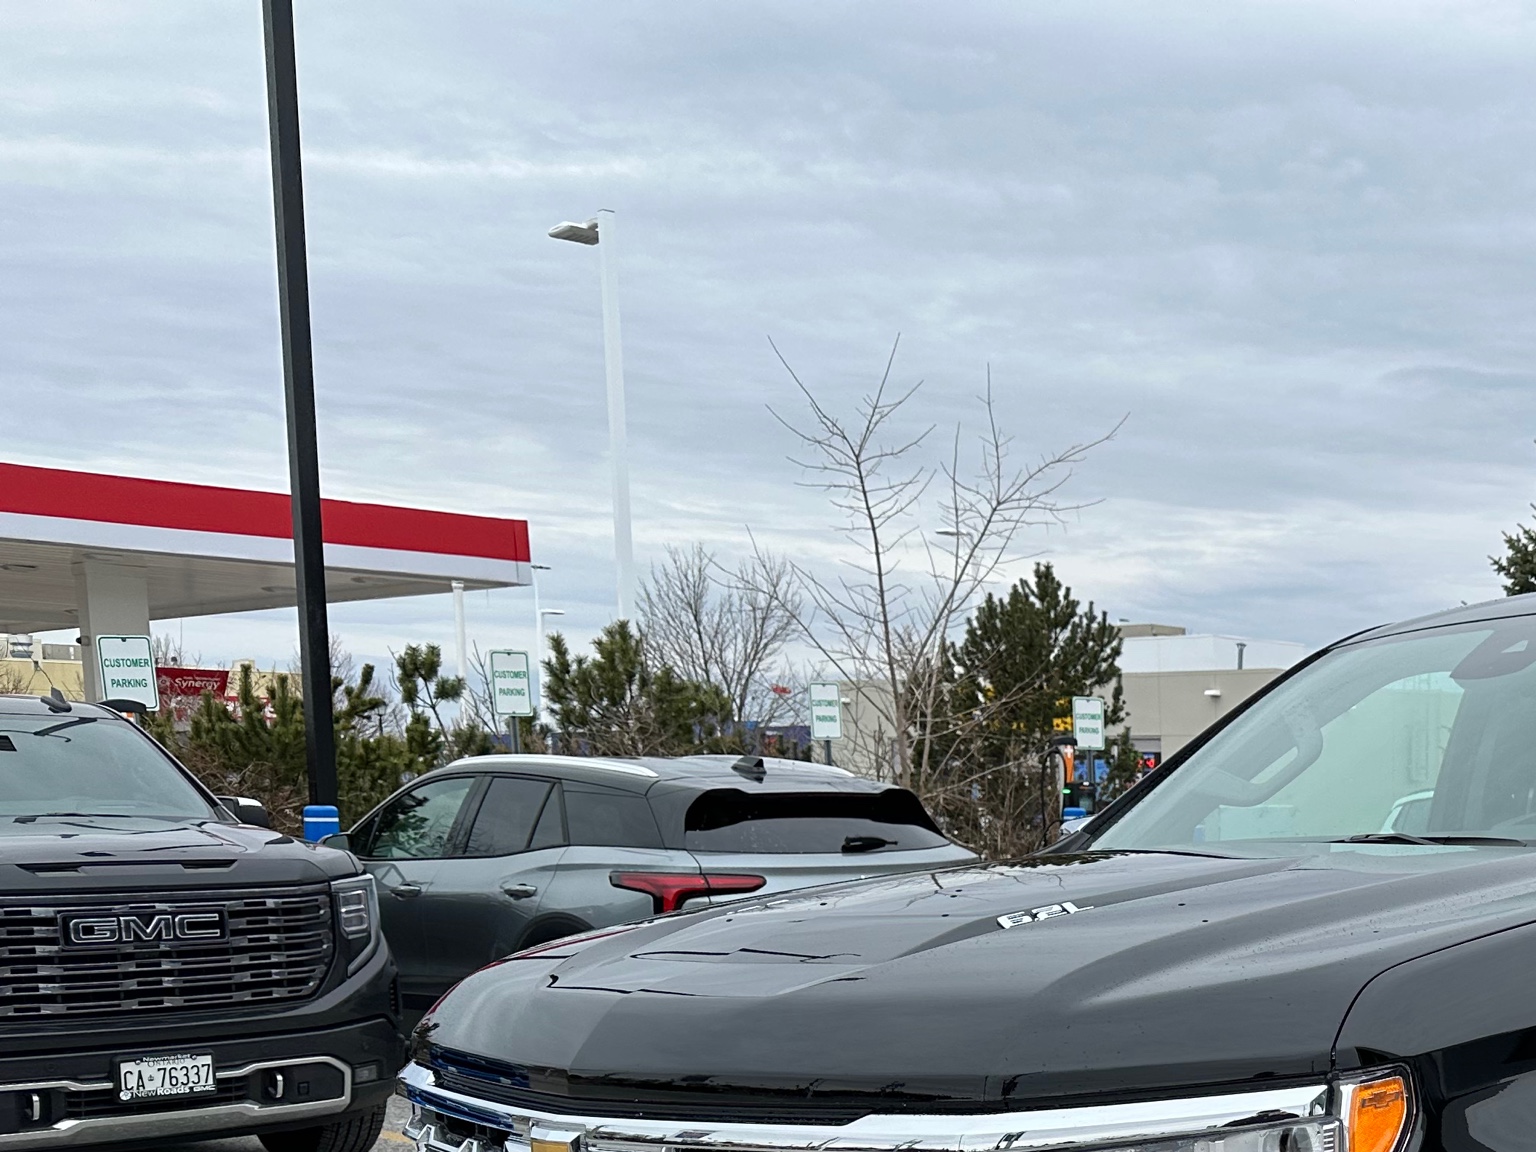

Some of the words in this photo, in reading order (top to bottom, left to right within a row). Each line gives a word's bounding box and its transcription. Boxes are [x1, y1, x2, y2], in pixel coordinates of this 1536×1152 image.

[104, 658, 149, 668] CUSTOMER
[494, 670, 527, 679] CUSTOMER
[111, 678, 148, 688] PARKING
[175, 677, 220, 690] Synergy
[499, 688, 526, 696] PARKING
[69, 913, 220, 943] GMC
[157, 1063, 211, 1088] 76337
